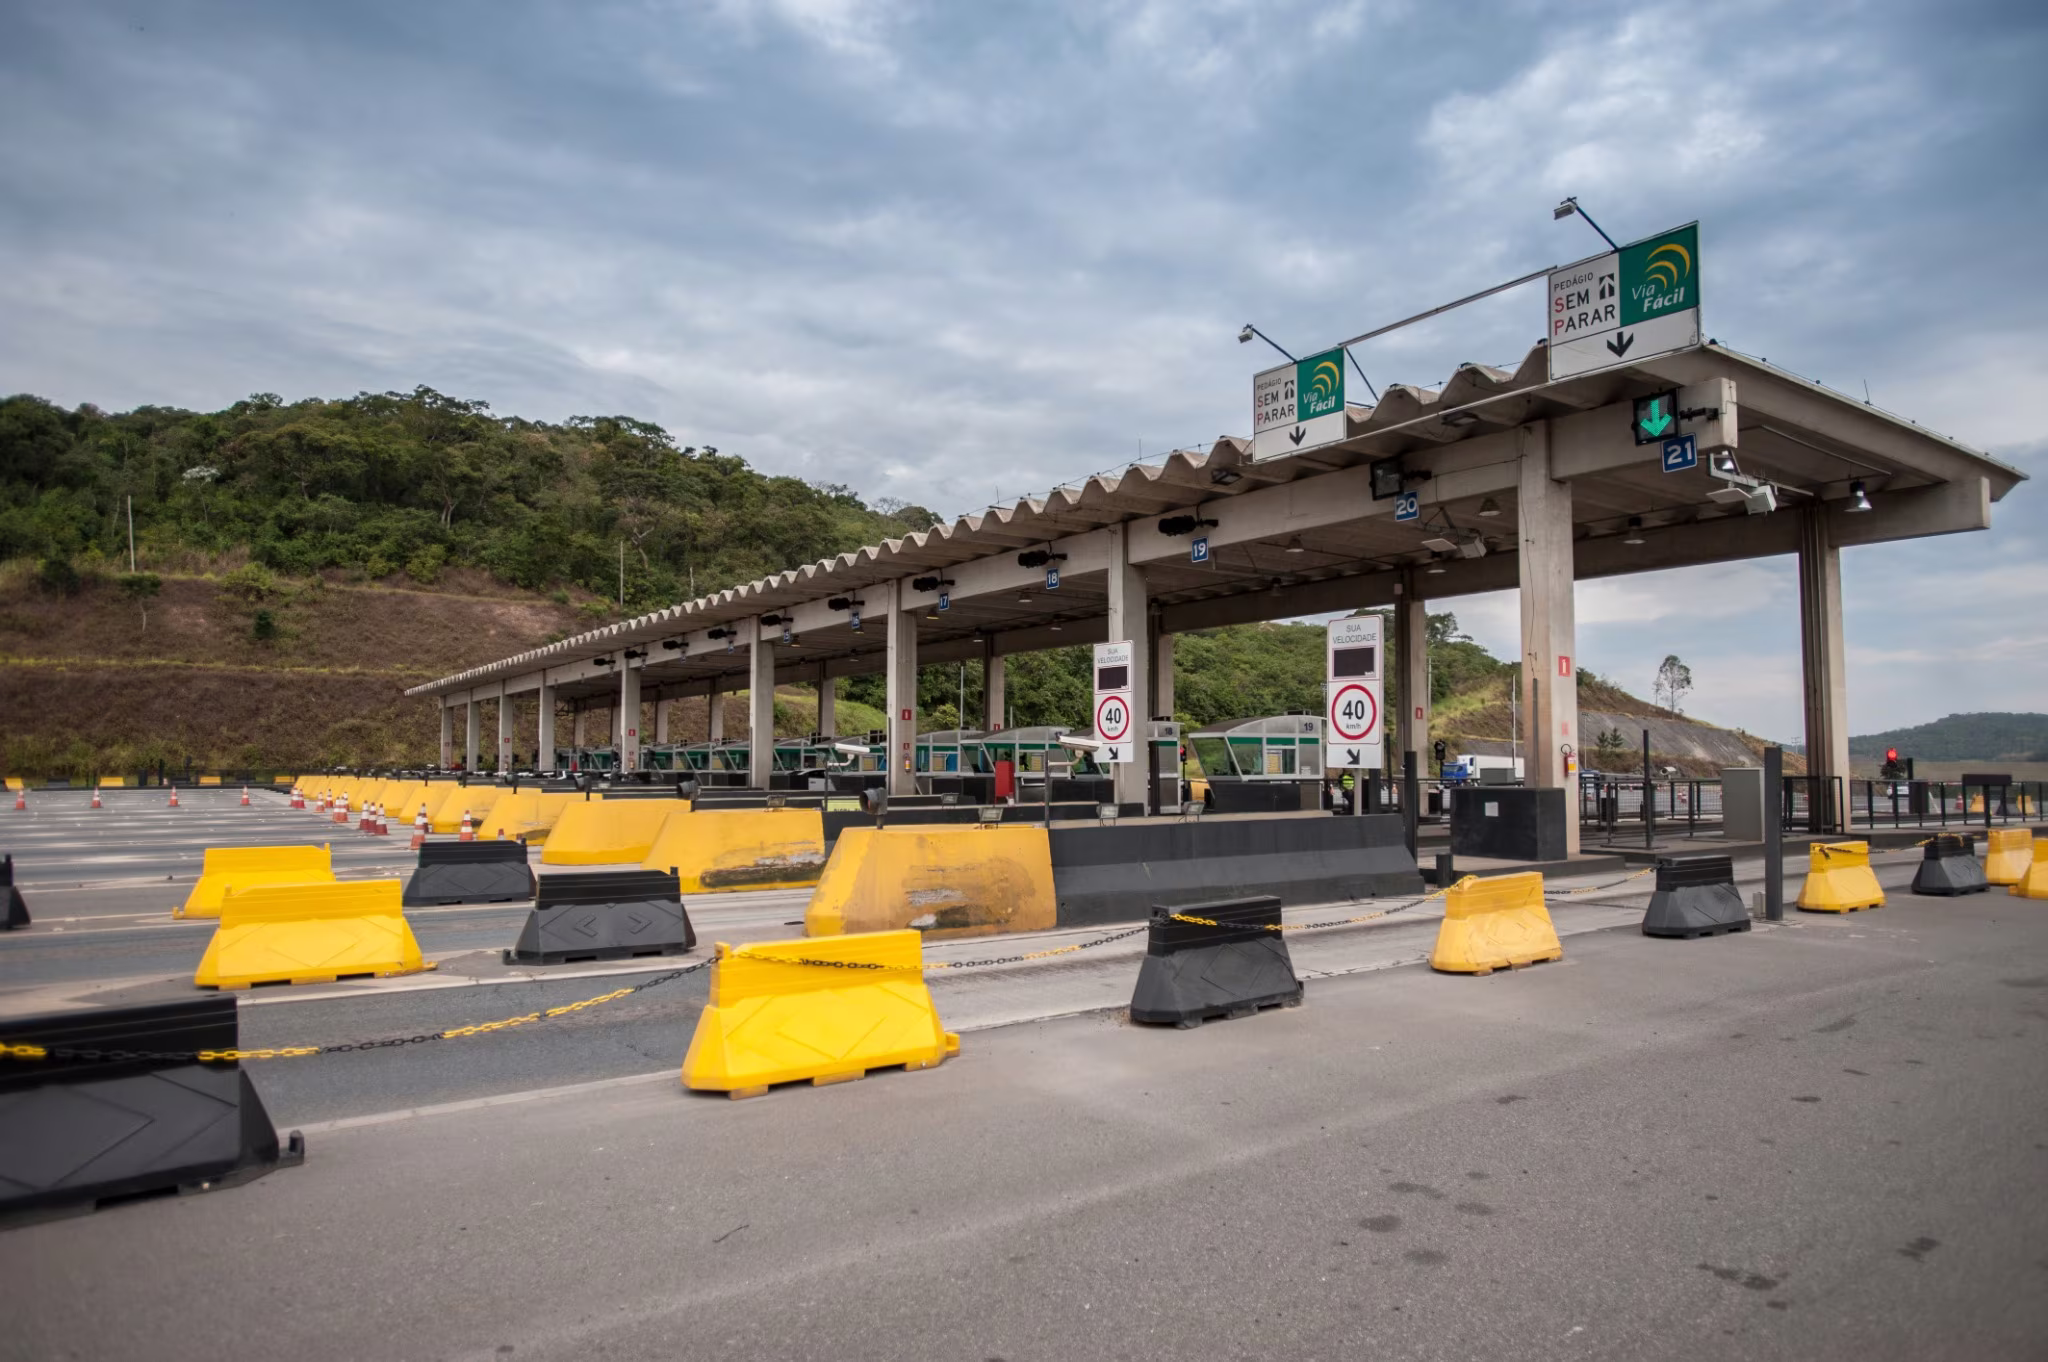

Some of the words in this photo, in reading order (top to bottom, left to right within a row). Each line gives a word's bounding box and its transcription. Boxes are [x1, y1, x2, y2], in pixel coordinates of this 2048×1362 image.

[1554, 272, 1594, 292] PEDÁGIO
[1632, 284, 1655, 300] Via
[1643, 286, 1685, 312] Fácil
[1555, 288, 1589, 313] SEM
[1554, 304, 1615, 336] PARAR
[1256, 377, 1282, 391] PEDÁGIO
[1257, 390, 1279, 408] SEM
[1303, 391, 1318, 404] Via
[1310, 396, 1336, 414] Fácil
[1256, 404, 1295, 426] PARAR
[1667, 441, 1693, 465] 21
[1396, 497, 1417, 515] 20
[1194, 542, 1206, 557] 19
[1048, 572, 1058, 585] 18
[940, 595, 948, 607] 17
[1346, 624, 1361, 633] SUA
[1332, 633, 1377, 644] VELOCIDADE
[1097, 655, 1128, 664] VELOCIDADE
[1105, 708, 1121, 724] 40
[1342, 700, 1365, 720] 40
[1165, 727, 1173, 735] 18
[1303, 722, 1314, 731] 19
